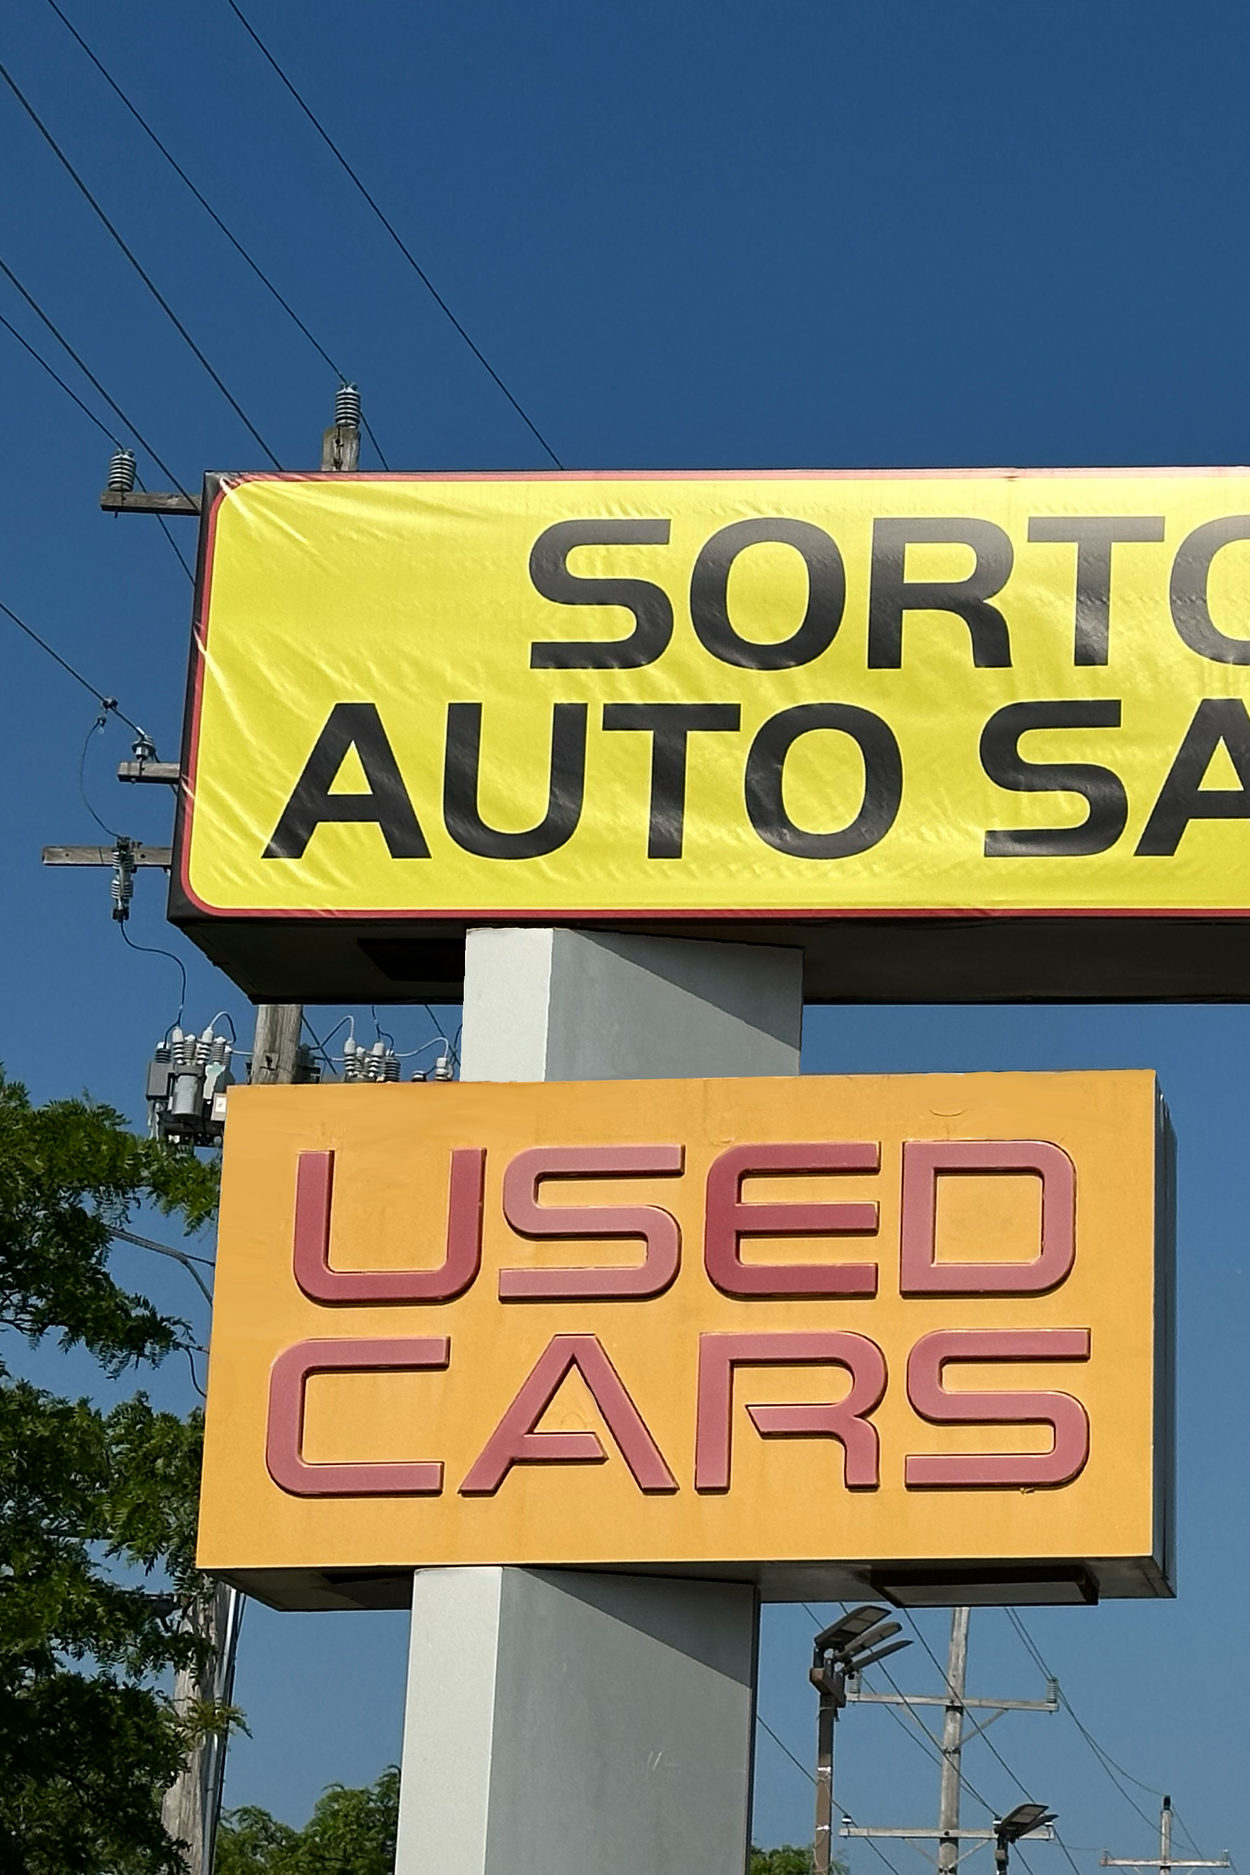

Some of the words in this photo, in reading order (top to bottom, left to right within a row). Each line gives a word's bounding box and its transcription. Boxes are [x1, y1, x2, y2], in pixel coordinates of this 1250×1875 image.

[262, 702, 904, 860] AUTO
[293, 1139, 1077, 1306] USED
[265, 1327, 1091, 1497] CARS
